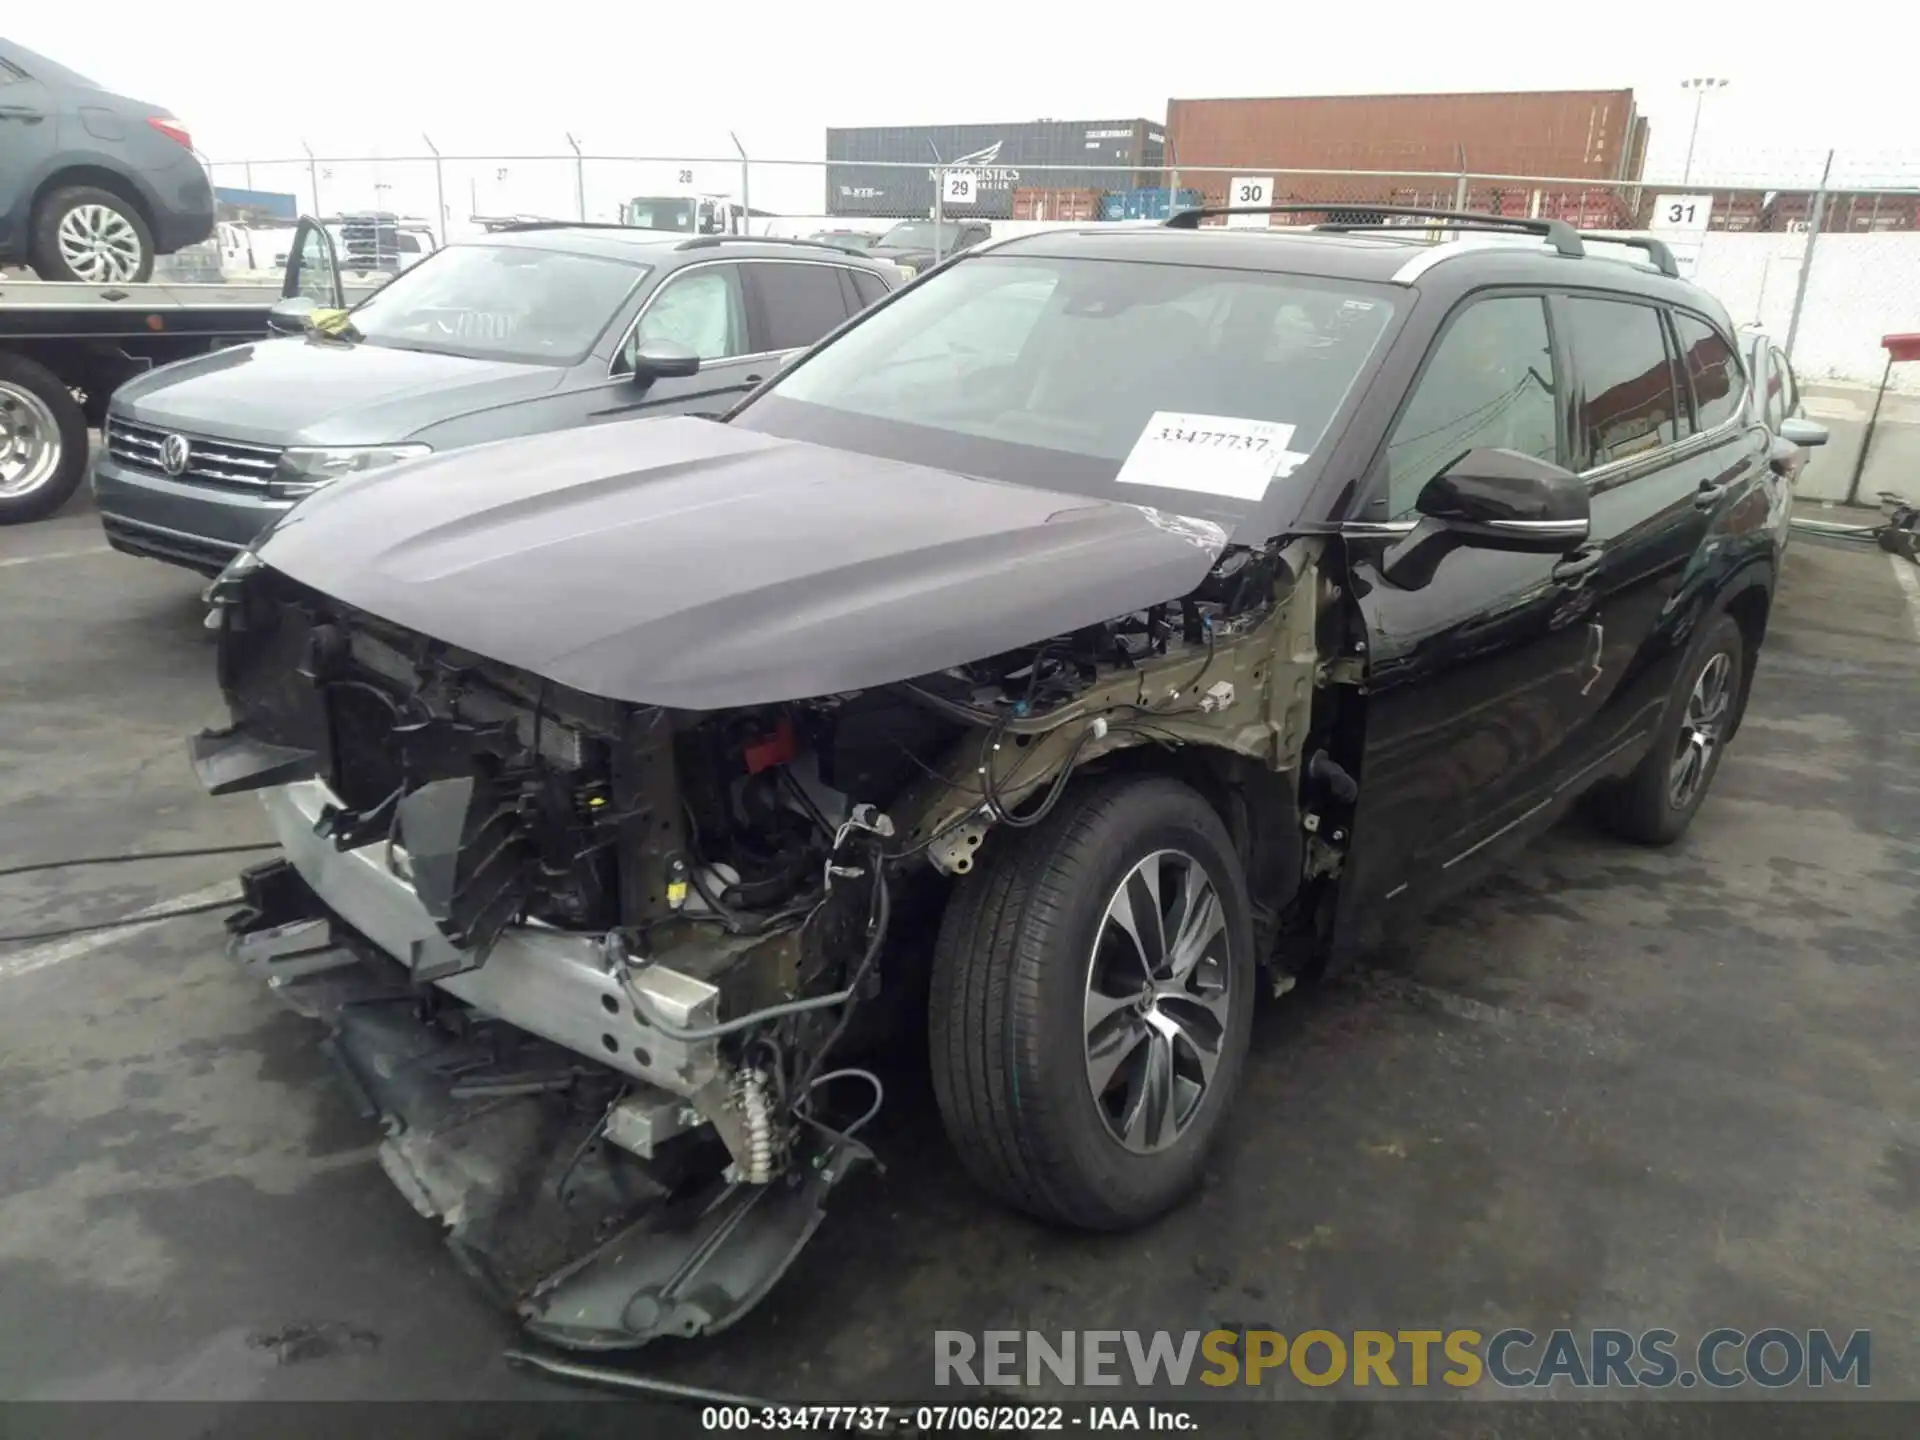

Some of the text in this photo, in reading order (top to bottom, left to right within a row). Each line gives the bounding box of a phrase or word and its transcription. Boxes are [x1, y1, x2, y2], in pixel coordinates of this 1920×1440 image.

[678, 169, 693, 184] 28
[951, 180, 969, 196] 29
[1239, 185, 1262, 202] 30
[1668, 204, 1696, 223] 31
